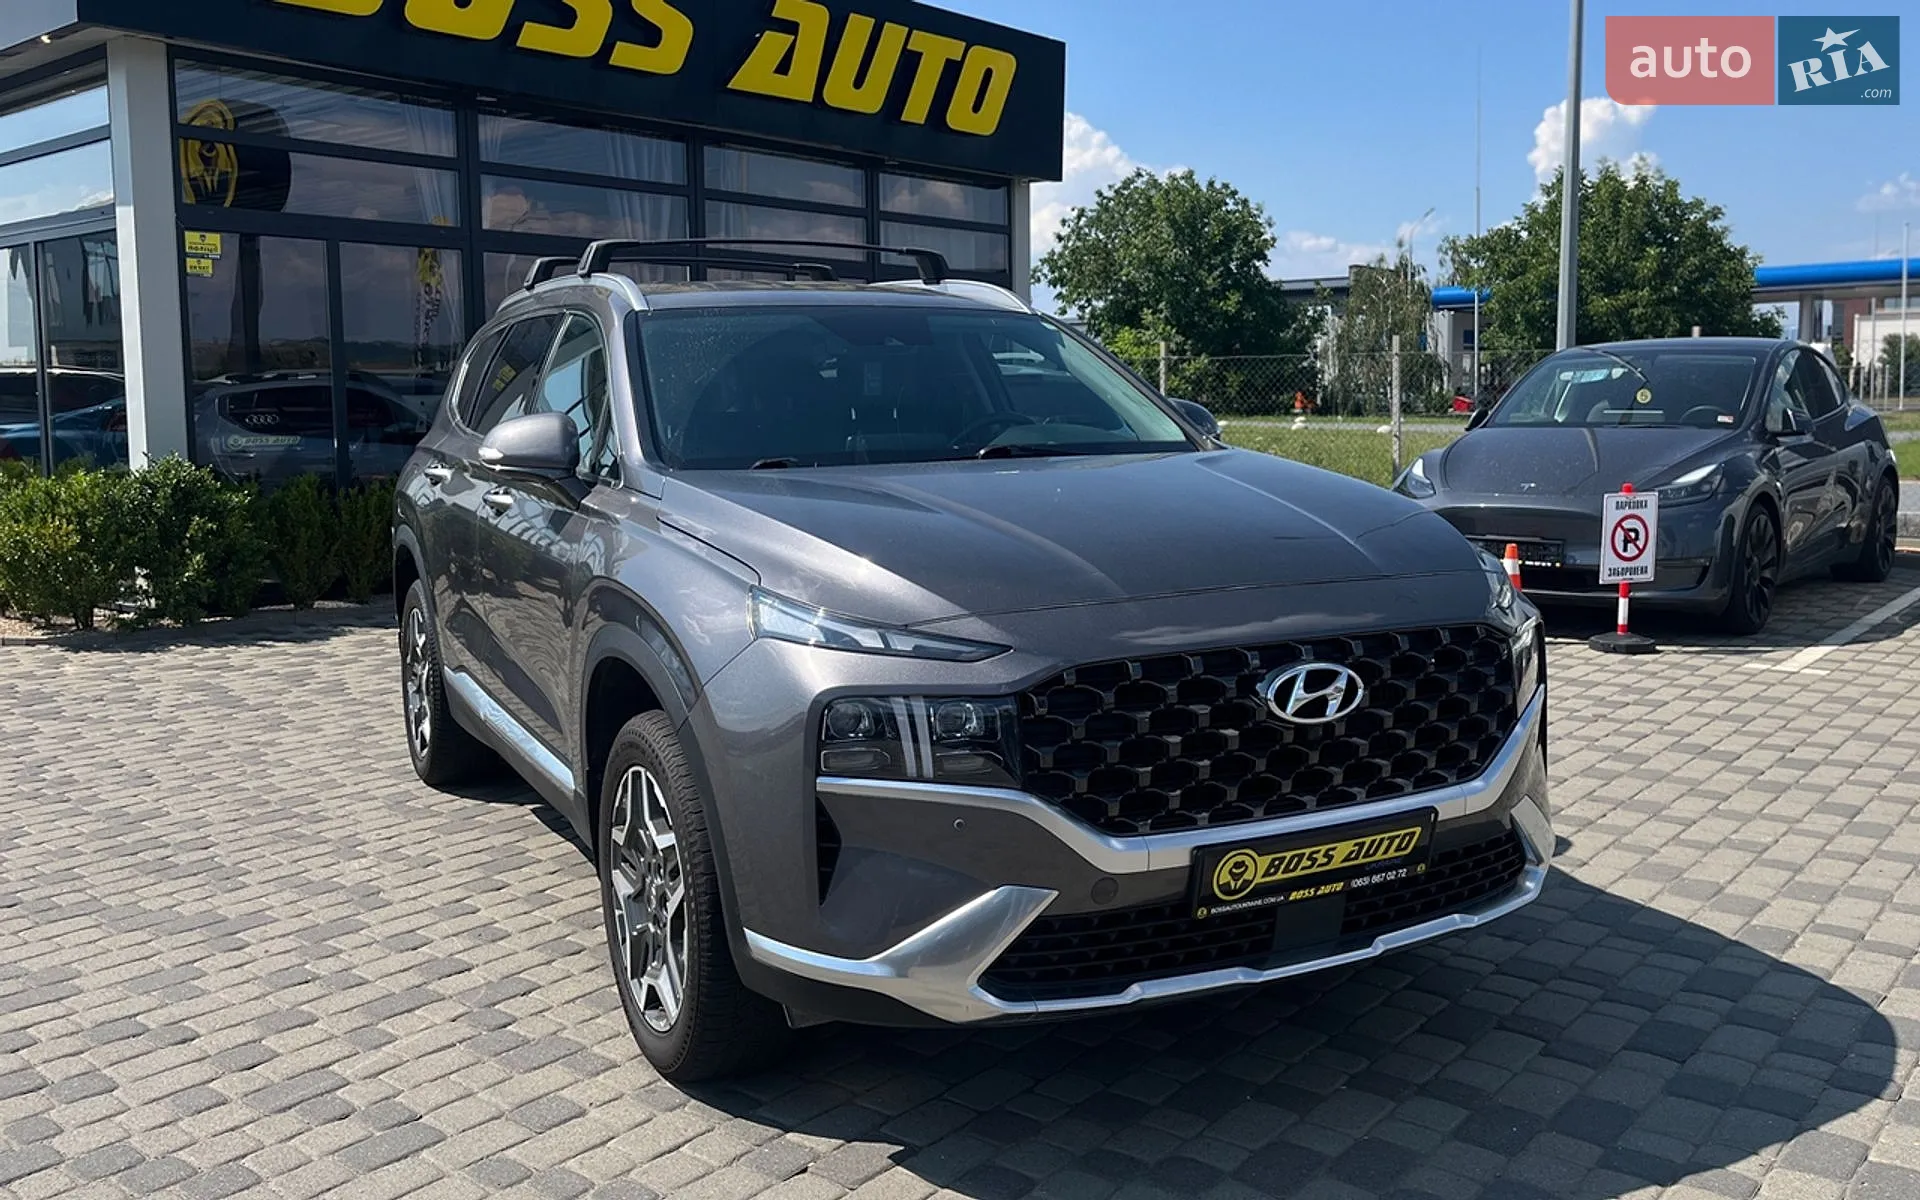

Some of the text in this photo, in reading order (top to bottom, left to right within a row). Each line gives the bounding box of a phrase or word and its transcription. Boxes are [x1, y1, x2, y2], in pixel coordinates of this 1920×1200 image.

[272, 0, 1017, 136] SS AUTO
[1615, 500, 1648, 510] ПАРКОВКА
[1607, 566, 1648, 577] ЗАБОРОНЕНА
[1262, 847, 1338, 879] BOSS
[1340, 831, 1417, 865] AUTO
[1289, 887, 1315, 900] BOSS
[1316, 882, 1344, 895] AUTO
[1386, 870, 1396, 881] 02
[1397, 868, 1407, 878] 72
